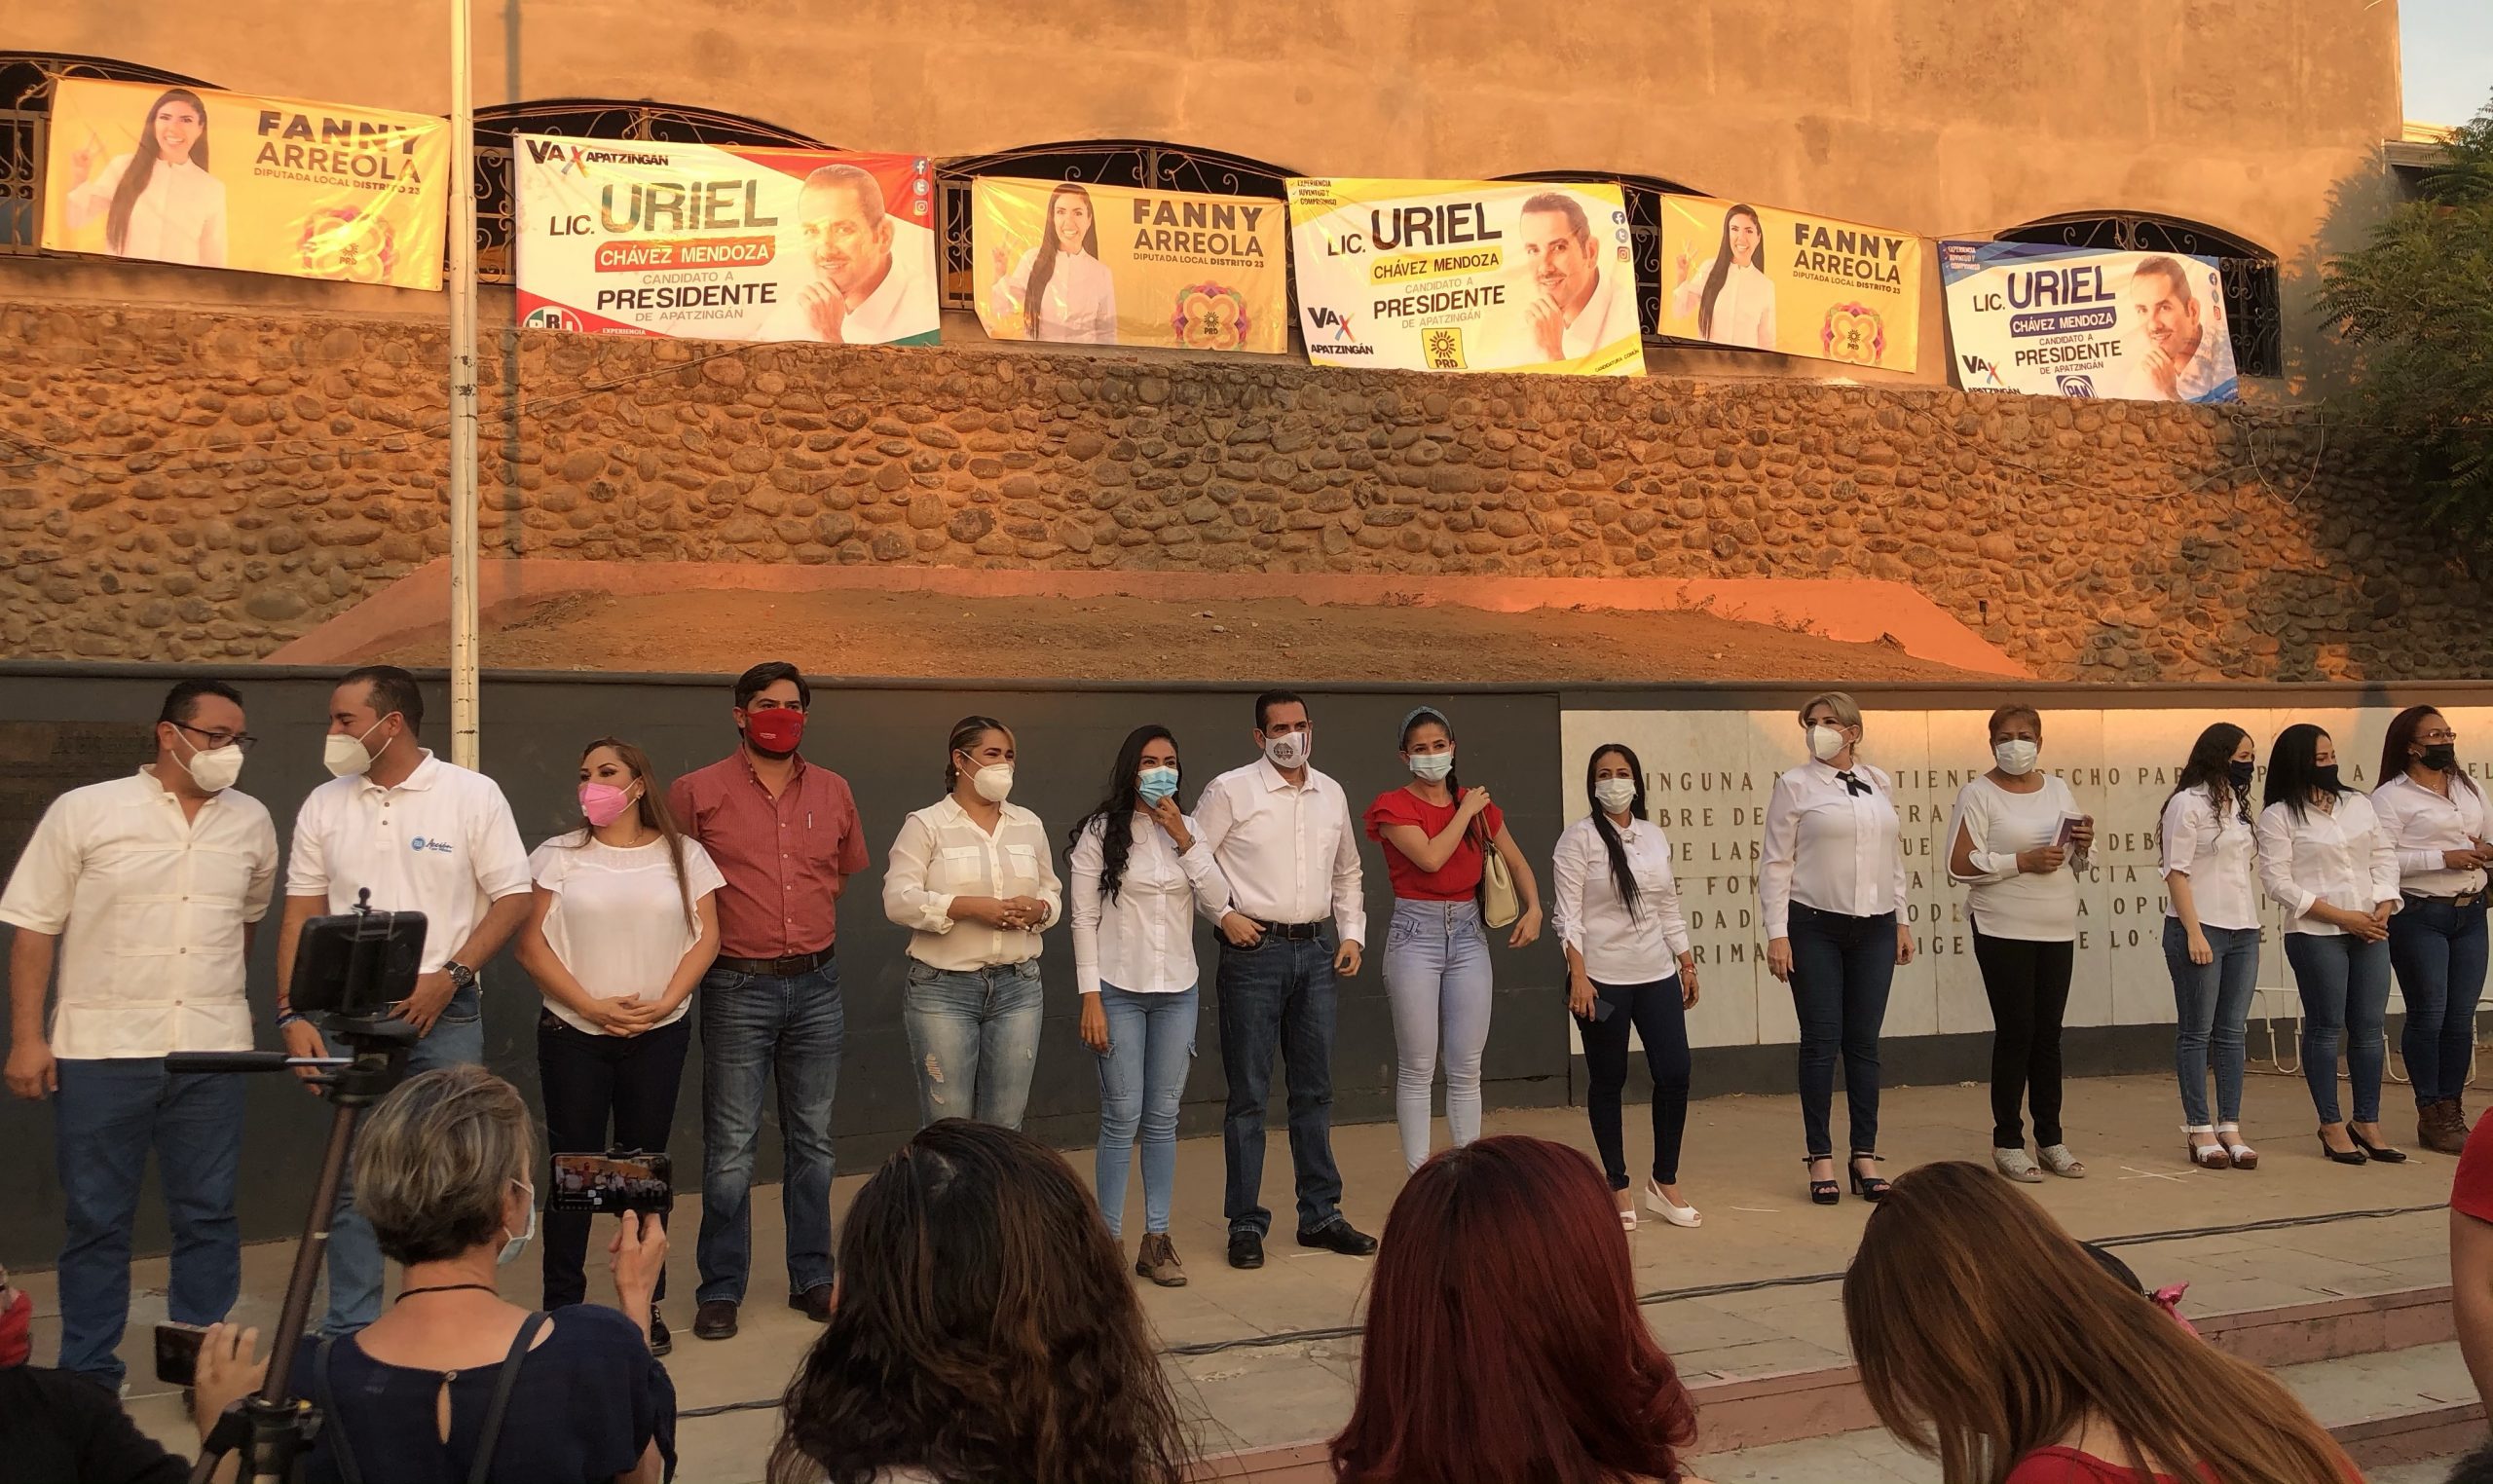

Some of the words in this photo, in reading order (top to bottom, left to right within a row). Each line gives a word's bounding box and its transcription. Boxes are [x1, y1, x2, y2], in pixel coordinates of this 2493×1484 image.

[258, 110, 421, 155] FANNY
[255, 141, 421, 183] ARREOLA
[254, 167, 311, 182] DIPUTADA
[314, 175, 350, 187] LOCAL
[549, 214, 595, 236] LIC.
[601, 179, 778, 233] URIEL
[1134, 198, 1263, 232] FANNY
[1327, 234, 1365, 256] LIC.
[1370, 203, 1503, 250] URIEL
[1134, 229, 1264, 257] ARREOLA
[1795, 223, 1904, 261] FANNY
[600, 245, 672, 266] CHÁVEZ
[682, 243, 769, 263] MENDOZA
[1134, 253, 1178, 263] DIPUTADA
[1179, 256, 1209, 265] LOCAL
[1210, 258, 1252, 267] DISTRITO
[1374, 259, 1428, 278] CHÁVEZ
[1433, 253, 1499, 273] MENDOZA
[643, 272, 719, 284] CANDIDATO
[725, 272, 733, 281] A
[1794, 249, 1901, 284] ARREOLA
[1405, 278, 1462, 294] CANDIDATO
[1467, 278, 1473, 286] A
[1793, 271, 1829, 282] DIPUTADA
[1831, 277, 1854, 286] LOCAL
[1856, 281, 1891, 292] DISTRITO
[1973, 293, 2005, 312] LIC.
[2008, 265, 2115, 309] URIEL
[597, 282, 777, 310] PRESIDENTE
[1373, 285, 1506, 318] PRESIDENTE
[635, 312, 652, 321] DE
[659, 306, 743, 320] APATZINGÁN
[1402, 319, 1417, 328] DE
[1419, 311, 1481, 327] APATZINGÁN
[2013, 317, 2055, 333] CHÁVEZ
[2060, 313, 2114, 329] MENDOZA
[1311, 343, 1374, 354] APATZINGÁN
[2039, 334, 2084, 346] CANDIDATO
[1434, 359, 1458, 368] PRD
[2015, 340, 2122, 366] PRESIDENTE
[2055, 361, 2103, 374] APATZINGÁN
[1712, 840, 1760, 861] LAS
